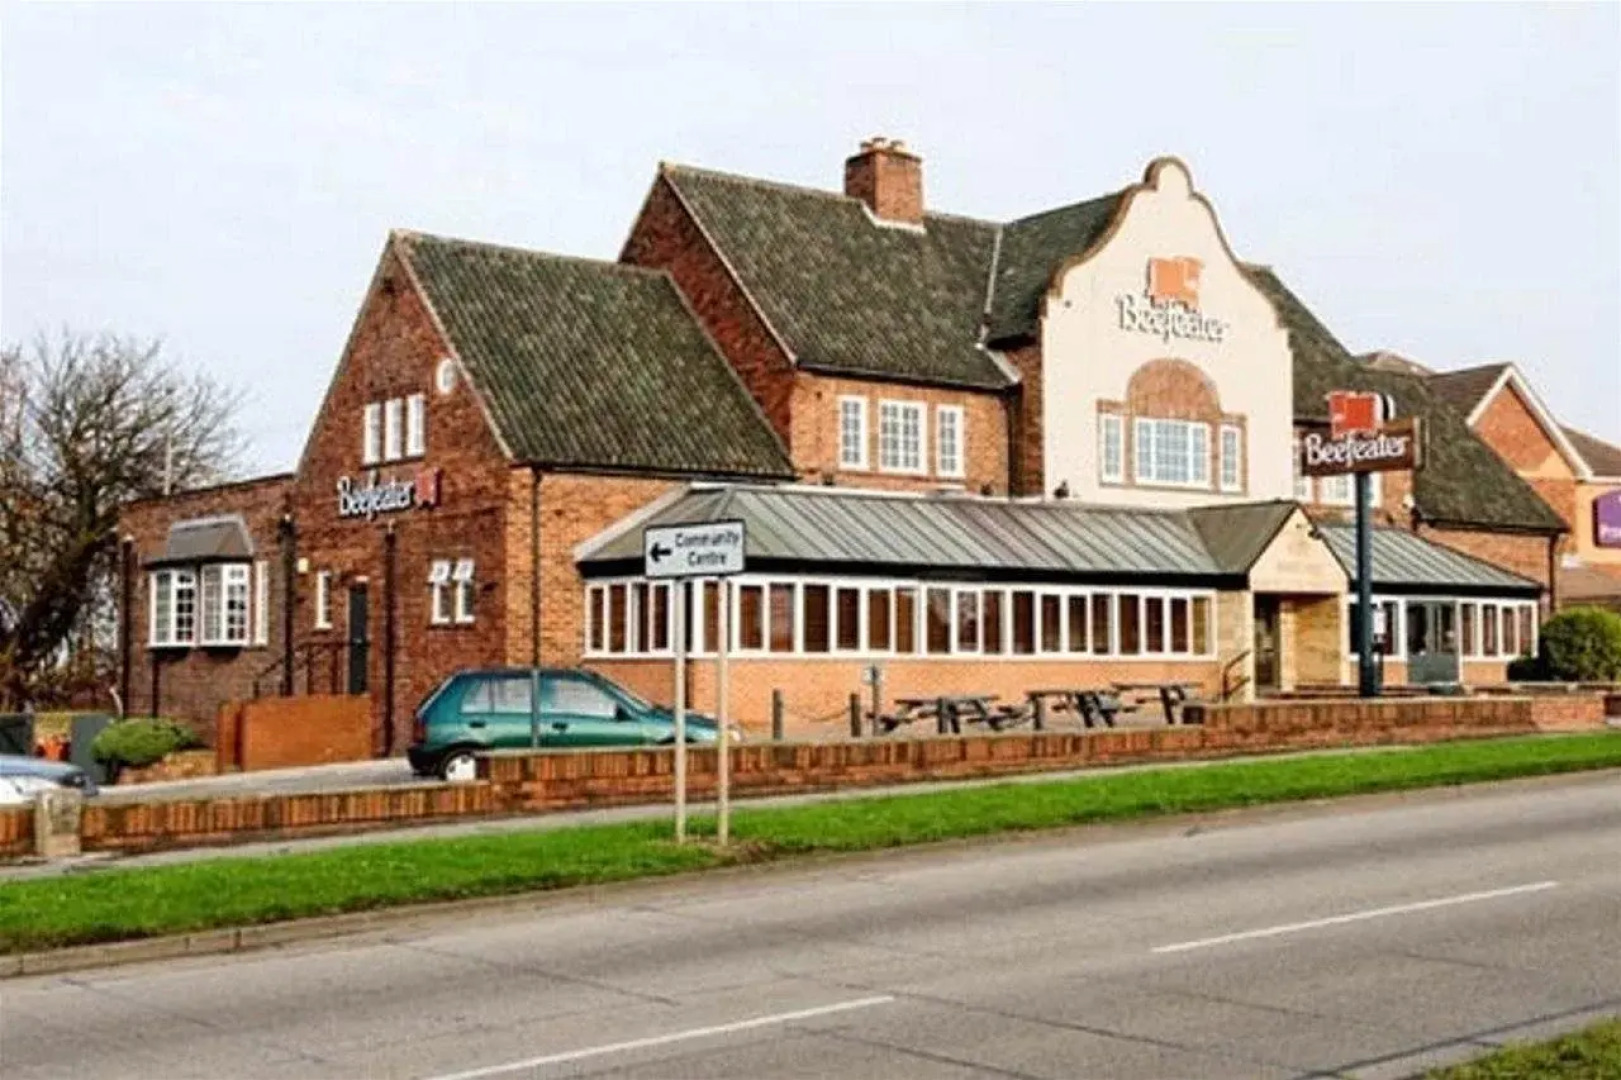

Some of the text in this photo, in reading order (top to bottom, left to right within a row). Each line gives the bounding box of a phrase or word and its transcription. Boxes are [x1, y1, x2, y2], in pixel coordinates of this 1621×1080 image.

[1115, 293, 1231, 344] Beefeater
[1304, 433, 1411, 468] Beefeater
[336, 470, 415, 521] Beefeater
[675, 531, 739, 548] Community
[688, 551, 727, 567] Centre
